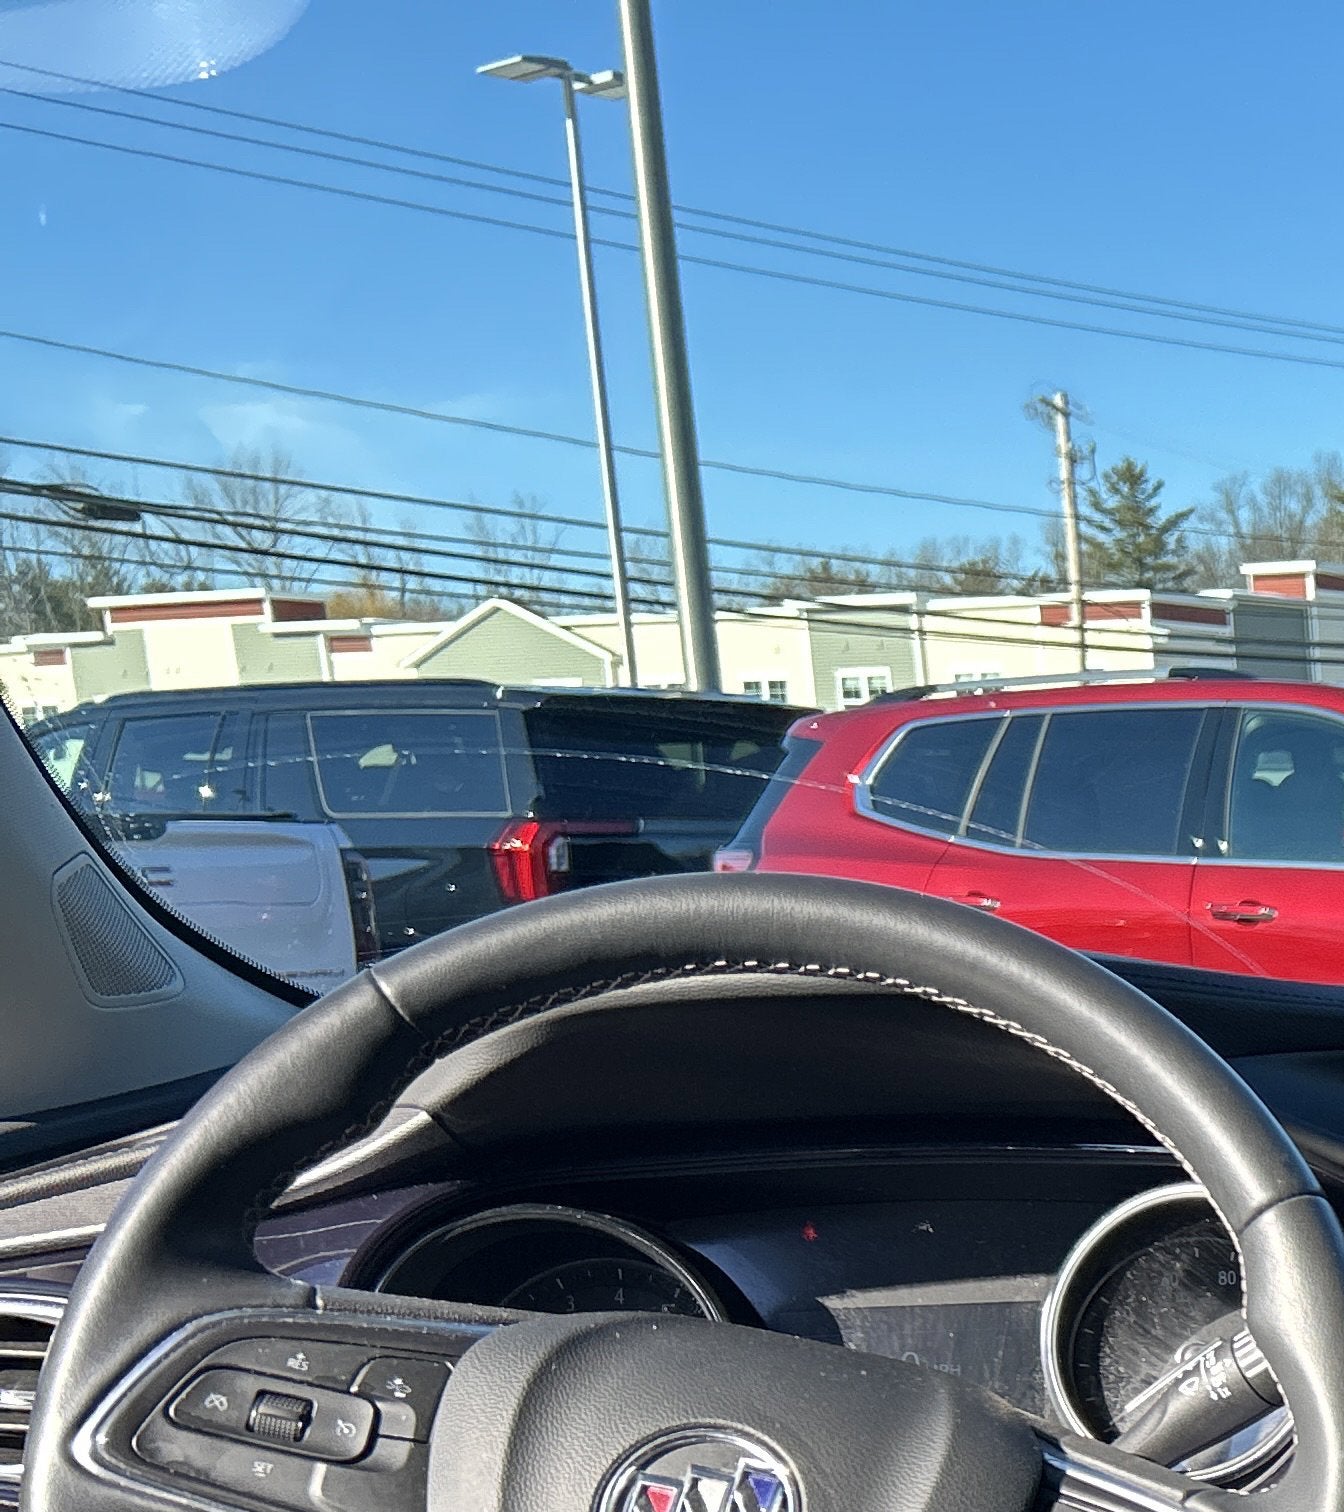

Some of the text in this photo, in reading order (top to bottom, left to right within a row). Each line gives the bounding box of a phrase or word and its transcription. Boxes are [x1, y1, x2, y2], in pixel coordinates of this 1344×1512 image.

[1217, 1270, 1237, 1286] 80
[565, 1295, 576, 1312] 3
[614, 1287, 625, 1305] 4
